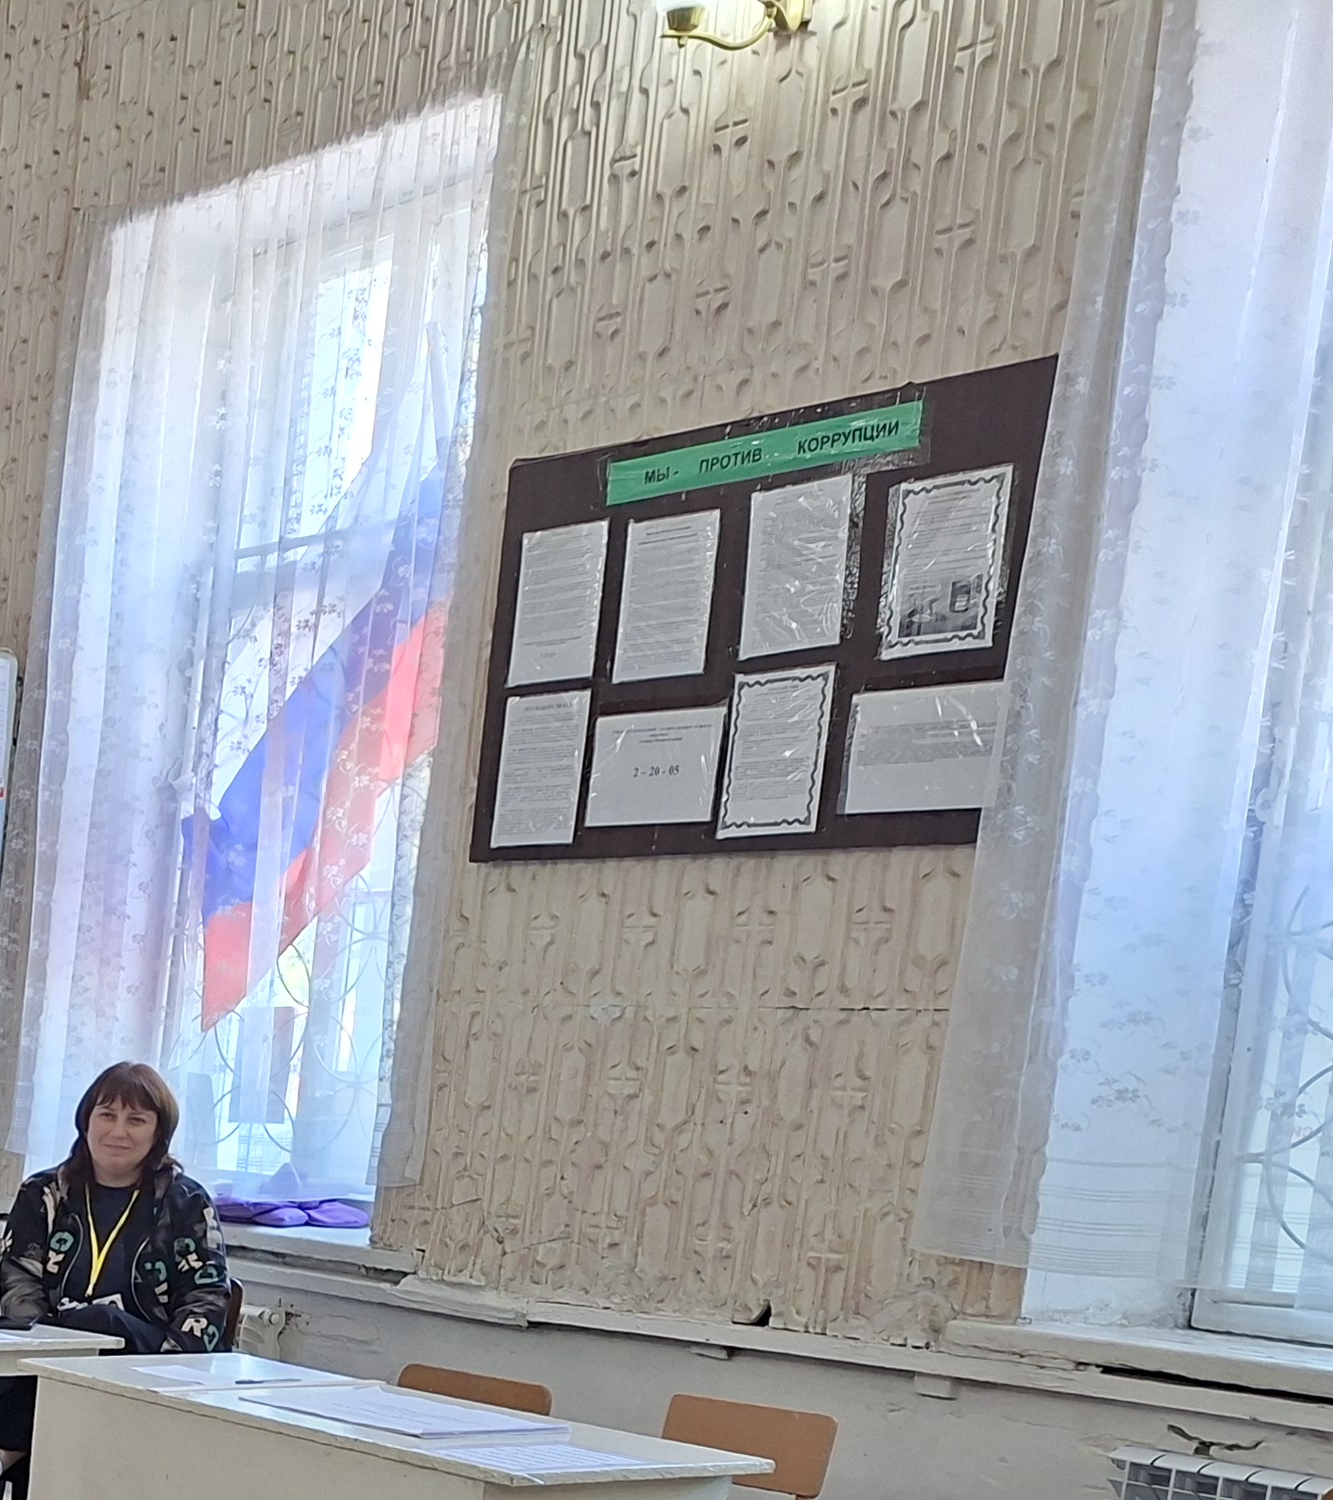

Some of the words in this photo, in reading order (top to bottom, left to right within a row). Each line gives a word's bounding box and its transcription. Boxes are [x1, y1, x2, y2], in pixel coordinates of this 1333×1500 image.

[699, 447, 763, 474] ПРОТИВ
[797, 419, 901, 455] КОРРУПЦИИ
[633, 767, 640, 777] 2
[648, 765, 661, 777] 20
[668, 764, 680, 775] 05
